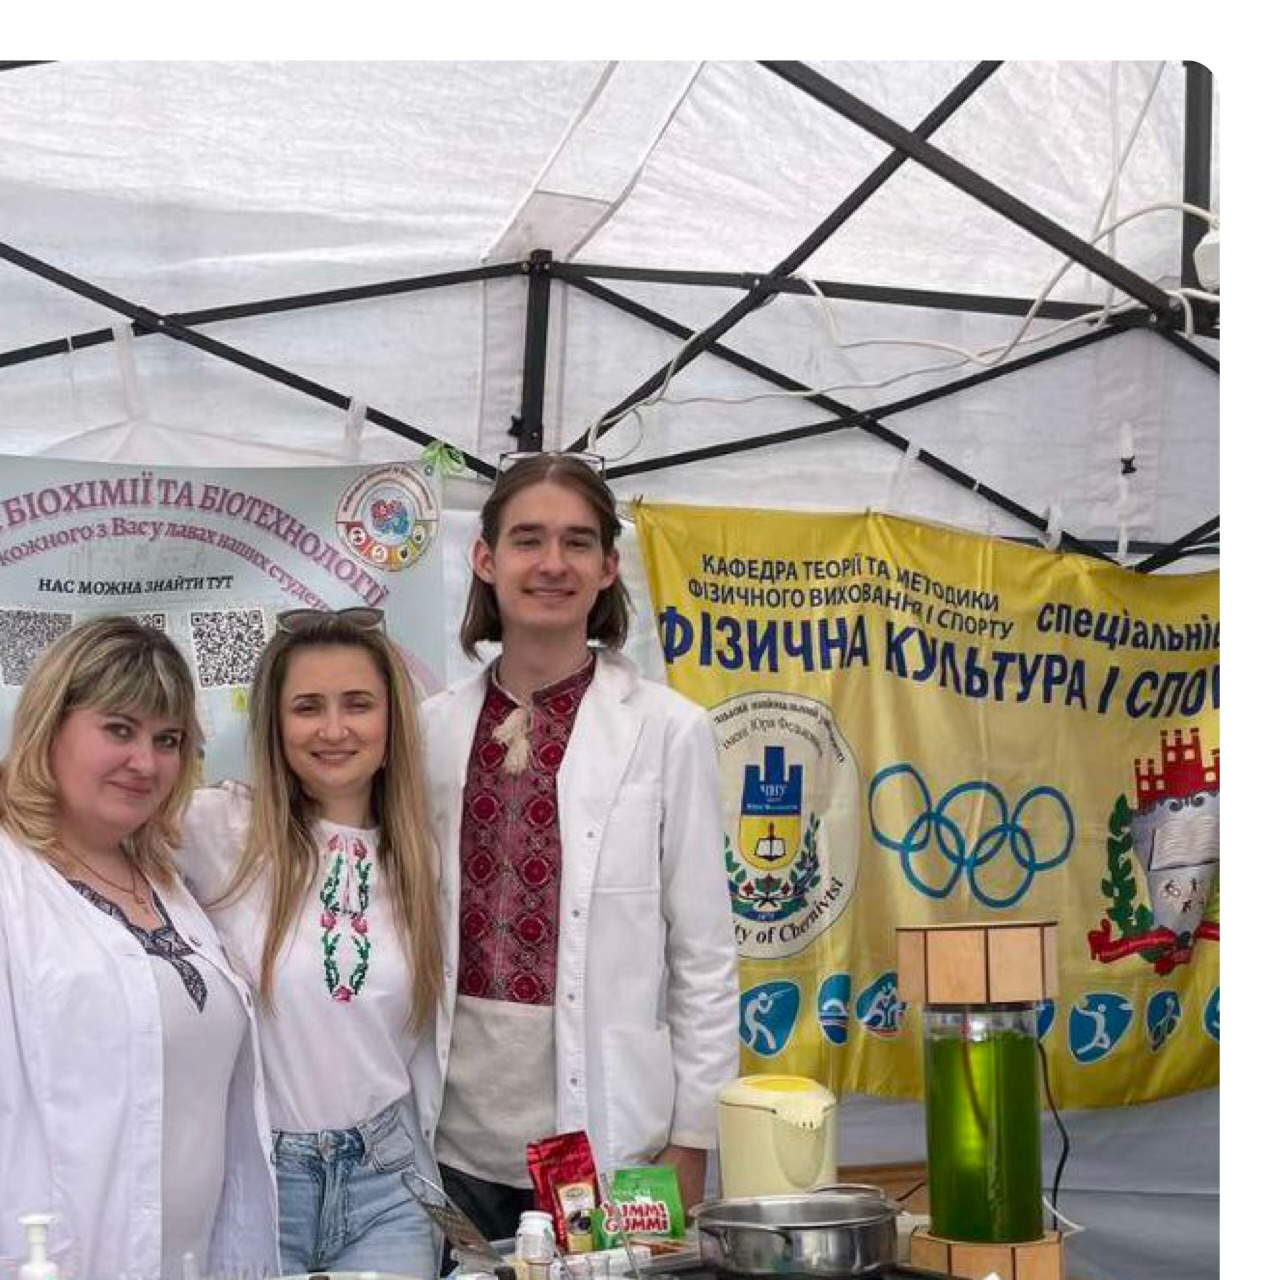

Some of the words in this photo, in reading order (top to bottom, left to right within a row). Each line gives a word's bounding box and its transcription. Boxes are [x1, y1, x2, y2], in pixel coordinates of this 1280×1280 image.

[1, 472, 153, 525] БІОХІМІЇ
[158, 479, 194, 507] ТА
[198, 484, 390, 607] БІОТЕХНОЛОГІЇ
[96, 522, 108, 537] з
[111, 516, 147, 537] Вас
[165, 521, 215, 544] лавах
[216, 532, 269, 572] наших
[39, 578, 74, 594] НАС
[78, 580, 142, 596] МОЖНА
[144, 574, 205, 594] ЗНАЙТИ
[206, 575, 234, 590] ТУТ
[688, 578, 804, 609] ФІЗИЧНОГО
[809, 584, 923, 618] ВИХОВАННЯ
[925, 604, 934, 624] І
[937, 609, 1014, 640] СПОРТУ
[702, 553, 798, 584] КАФЕДРА
[802, 554, 862, 580] ТЕОРІЇ
[866, 555, 890, 579] ТА
[897, 567, 999, 613] МЕТОДИКИ
[659, 604, 870, 673] ФІЗИЧНА
[885, 619, 1087, 711] КУЛЬТУРА
[1097, 665, 1120, 714] І
[755, 923, 775, 945] of
[778, 876, 844, 944] Chernivtsi
